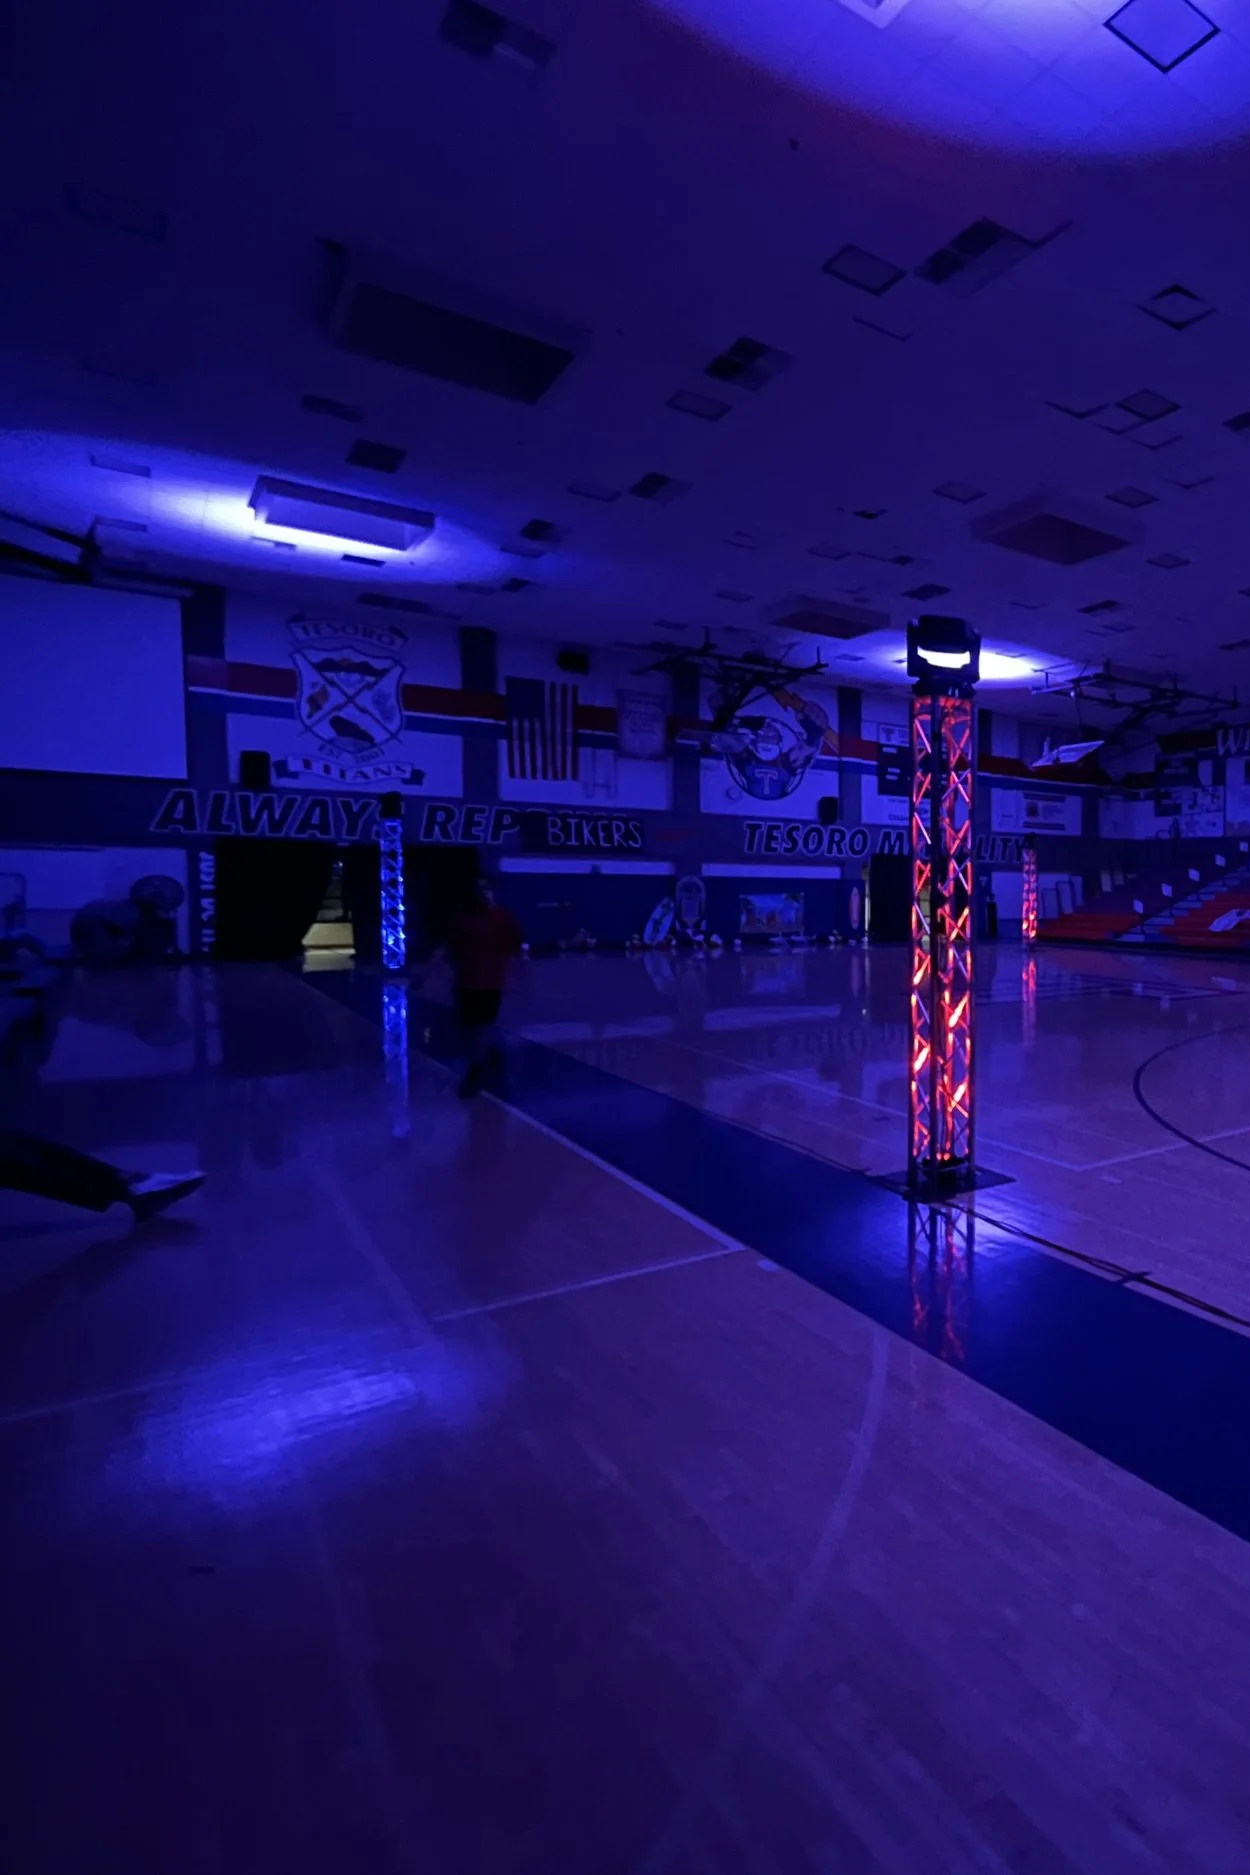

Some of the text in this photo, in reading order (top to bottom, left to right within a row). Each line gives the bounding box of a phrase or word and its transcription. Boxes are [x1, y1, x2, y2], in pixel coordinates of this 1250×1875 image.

[149, 787, 405, 842] ALWAY
[546, 815, 643, 850] BIKERS
[742, 819, 870, 858] TESORO
